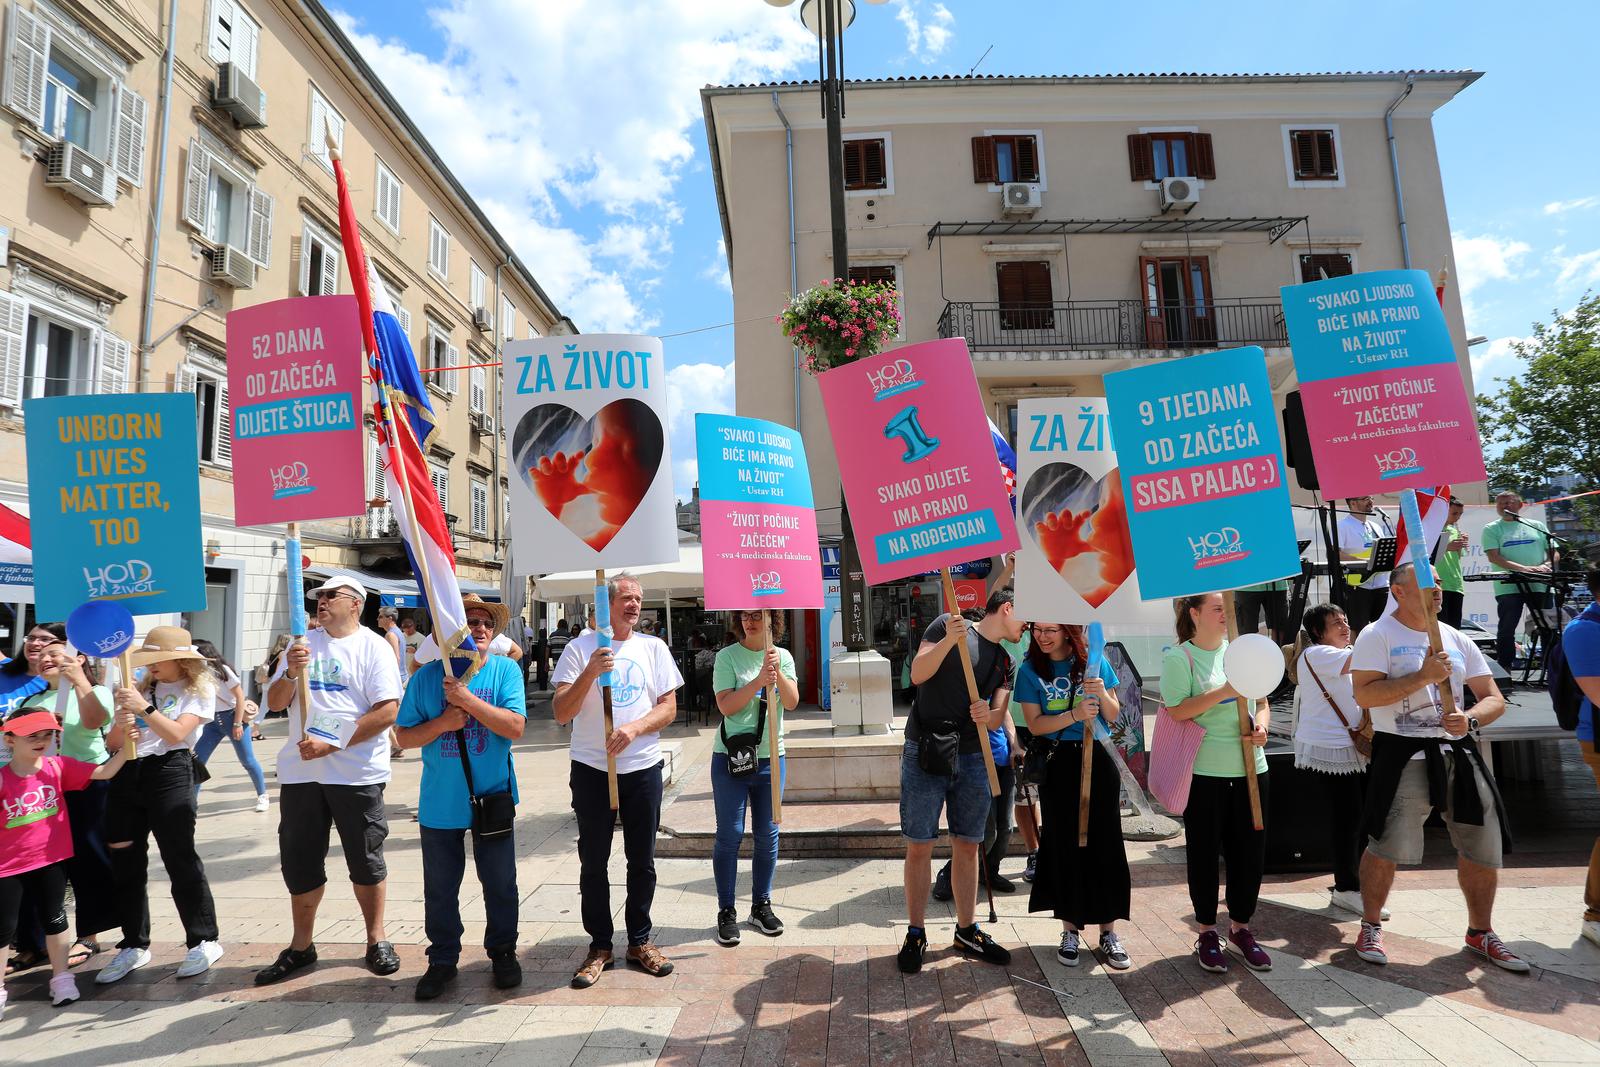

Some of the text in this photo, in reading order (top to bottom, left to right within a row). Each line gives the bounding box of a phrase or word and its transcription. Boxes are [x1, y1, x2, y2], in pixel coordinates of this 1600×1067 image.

[1363, 284, 1415, 303] LJUDSKO
[1318, 306, 1420, 334] BIĆE IMA PRAVO
[252, 326, 325, 360] 52 DANA
[1342, 336, 1362, 352] NA
[1356, 352, 1388, 364] Ustav
[1391, 348, 1409, 360] RH
[246, 359, 337, 398] OD ZAČEĆA
[516, 344, 652, 395] ZA ŽIVOT
[866, 359, 912, 387] HOD
[872, 381, 886, 393] ZA
[888, 372, 916, 388] ŽIVOT
[1384, 378, 1437, 398] POČINJE
[1138, 382, 1252, 426] 9 TJEDANA
[58, 412, 162, 444] UNBORN
[238, 399, 350, 437] DIJETE ŠTUCA
[1029, 406, 1116, 452] ZA ŽI
[758, 431, 792, 450] LJUDSKO
[1144, 418, 1260, 465] OD ZAČEĆA
[1332, 434, 1349, 444] sva
[1350, 432, 1358, 442] 4
[1359, 423, 1418, 440] medicinska
[1418, 418, 1460, 433] fakulteta
[76, 447, 148, 478] LIVES
[722, 447, 794, 468] BIĆE IMA PRAVO
[1374, 447, 1416, 467] HOD
[1379, 460, 1420, 472] ZA ŽIVOT
[270, 461, 308, 484] HOD
[273, 476, 310, 490] ZA ŽIVOT
[738, 470, 752, 482] NA
[1136, 474, 1186, 506] SISA
[1190, 462, 1256, 498] PALAC
[747, 486, 770, 496] Ustav
[771, 488, 784, 497] RH
[878, 466, 972, 504] SVAKO DIJETE
[60, 481, 170, 514] MATTER,
[763, 512, 800, 530] POČINJE
[892, 494, 968, 528] IMA PRAVO
[90, 516, 140, 546] TOO
[888, 517, 986, 556] NA ROĐENDAN
[1188, 526, 1240, 553] HOD
[741, 551, 784, 560] medicinska
[784, 552, 812, 562] fakulteta
[1193, 549, 1208, 560] ZA
[1211, 542, 1244, 556] ŽIVOT
[82, 560, 152, 588] HOD
[750, 570, 780, 586] HOD
[88, 580, 156, 598] ZA ŽIVOT
[1047, 690, 1062, 700] ZA
[732, 764, 752, 772] adidas
[3, 784, 56, 814] HOD
[7, 798, 59, 820] ZA ŽIVOT
